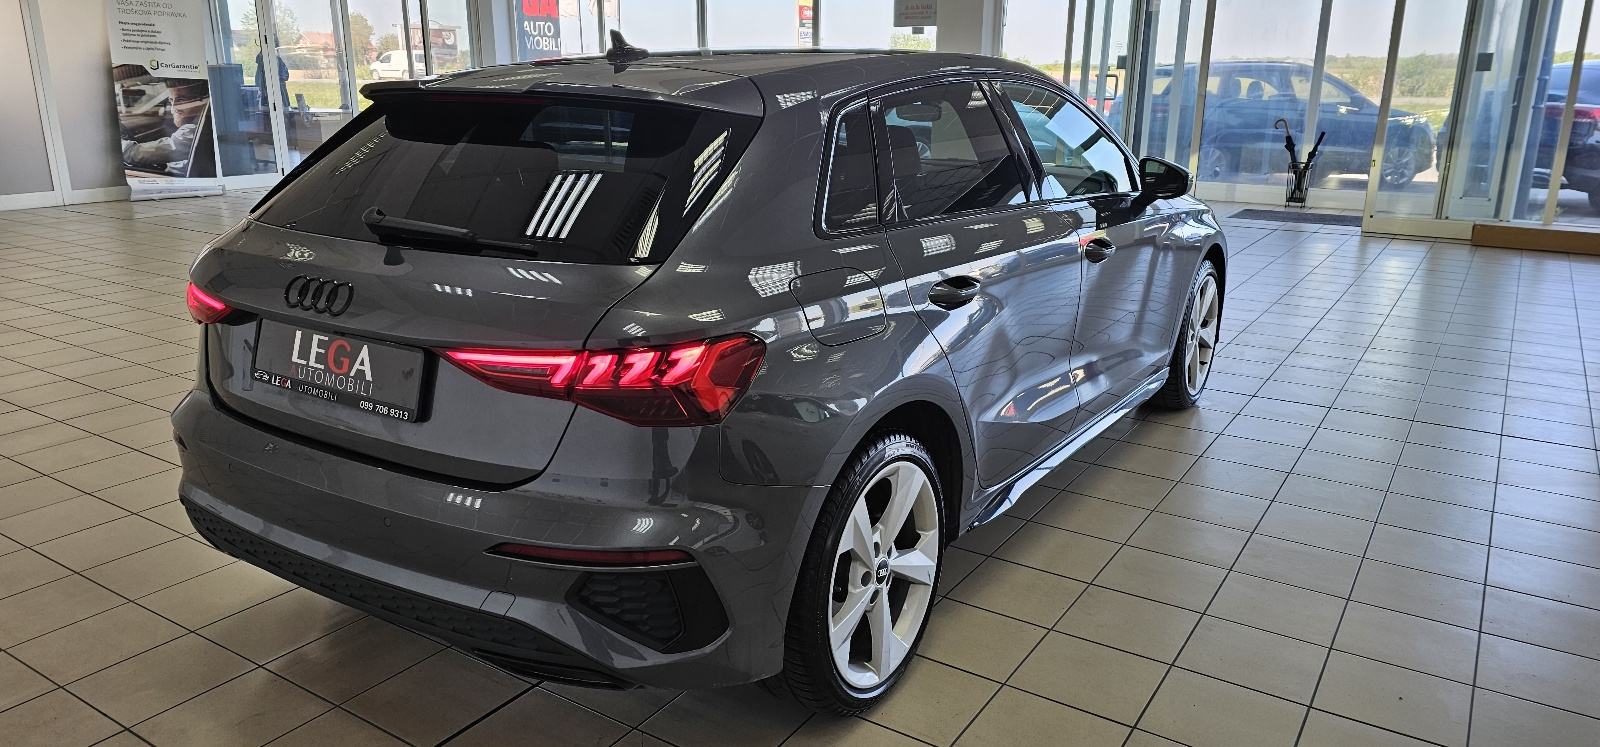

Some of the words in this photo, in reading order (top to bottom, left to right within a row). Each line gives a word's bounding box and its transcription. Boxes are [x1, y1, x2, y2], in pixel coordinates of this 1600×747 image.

[523, 20, 554, 36] AUTO
[160, 62, 199, 70] CarGarantie
[291, 329, 373, 382] LEGA
[271, 374, 292, 389] LEGA
[297, 384, 337, 402] UTOMOBILI
[359, 400, 374, 411] 099
[375, 404, 389, 415] 706
[389, 408, 409, 421] 9313
